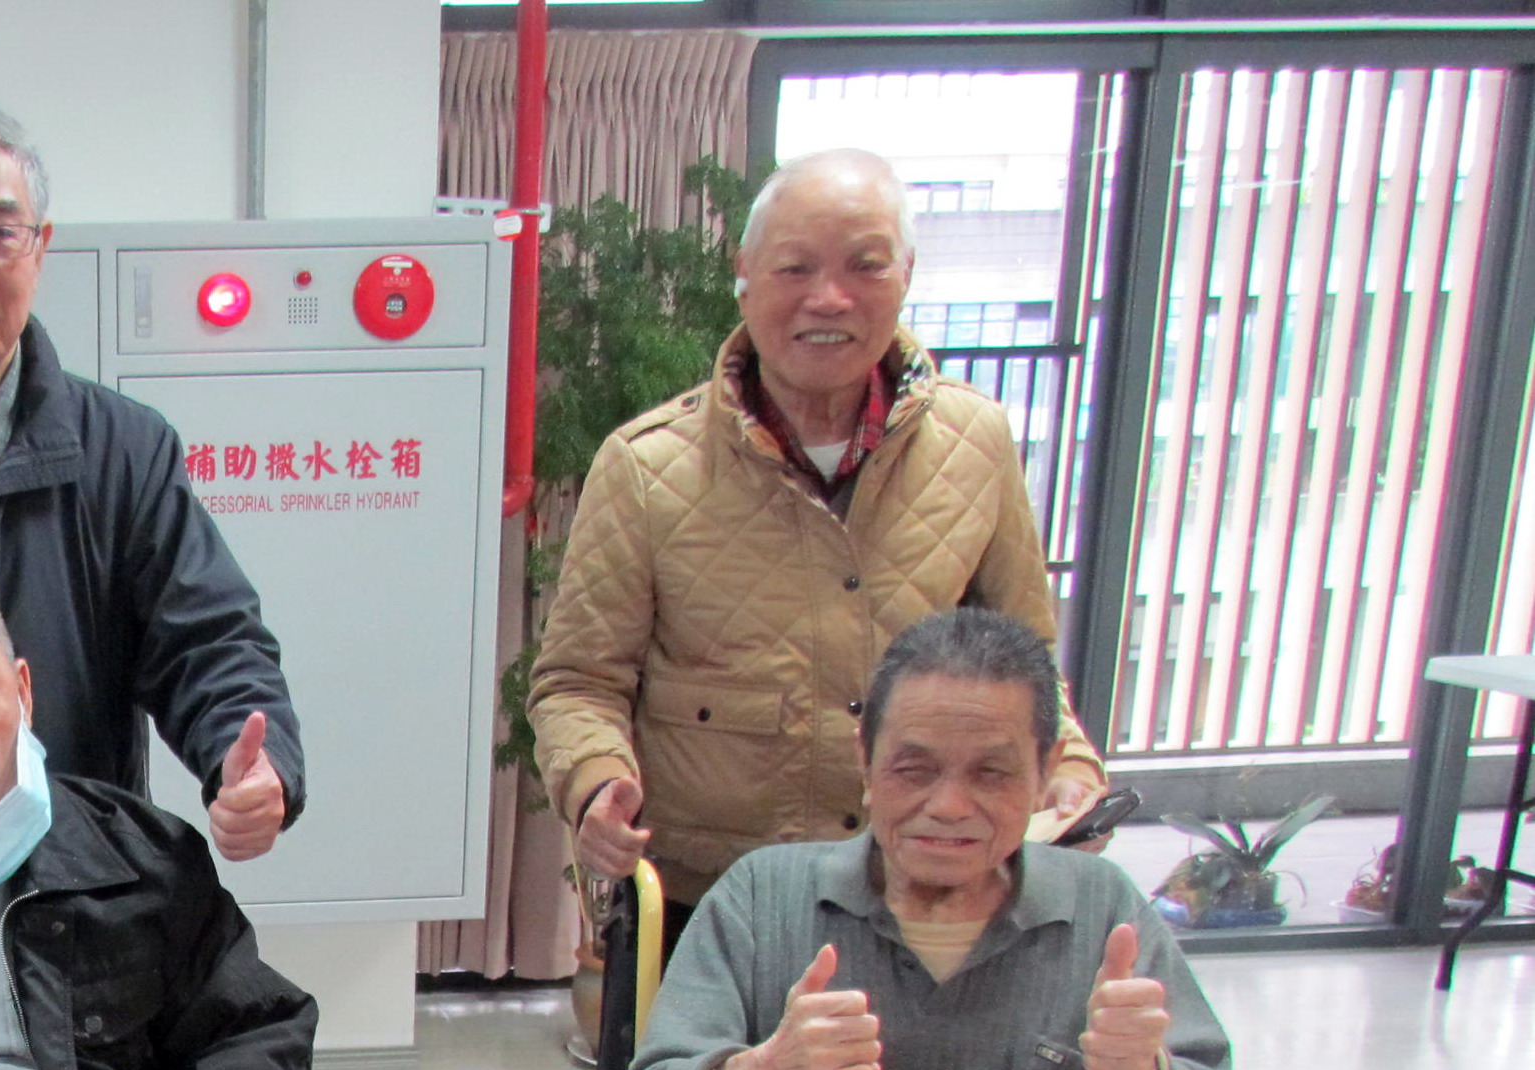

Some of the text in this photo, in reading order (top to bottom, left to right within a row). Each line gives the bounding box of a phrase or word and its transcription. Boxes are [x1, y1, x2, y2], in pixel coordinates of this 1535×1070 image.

[200, 491, 421, 514] CESSORIAL SPRINKLER HYDRANT
